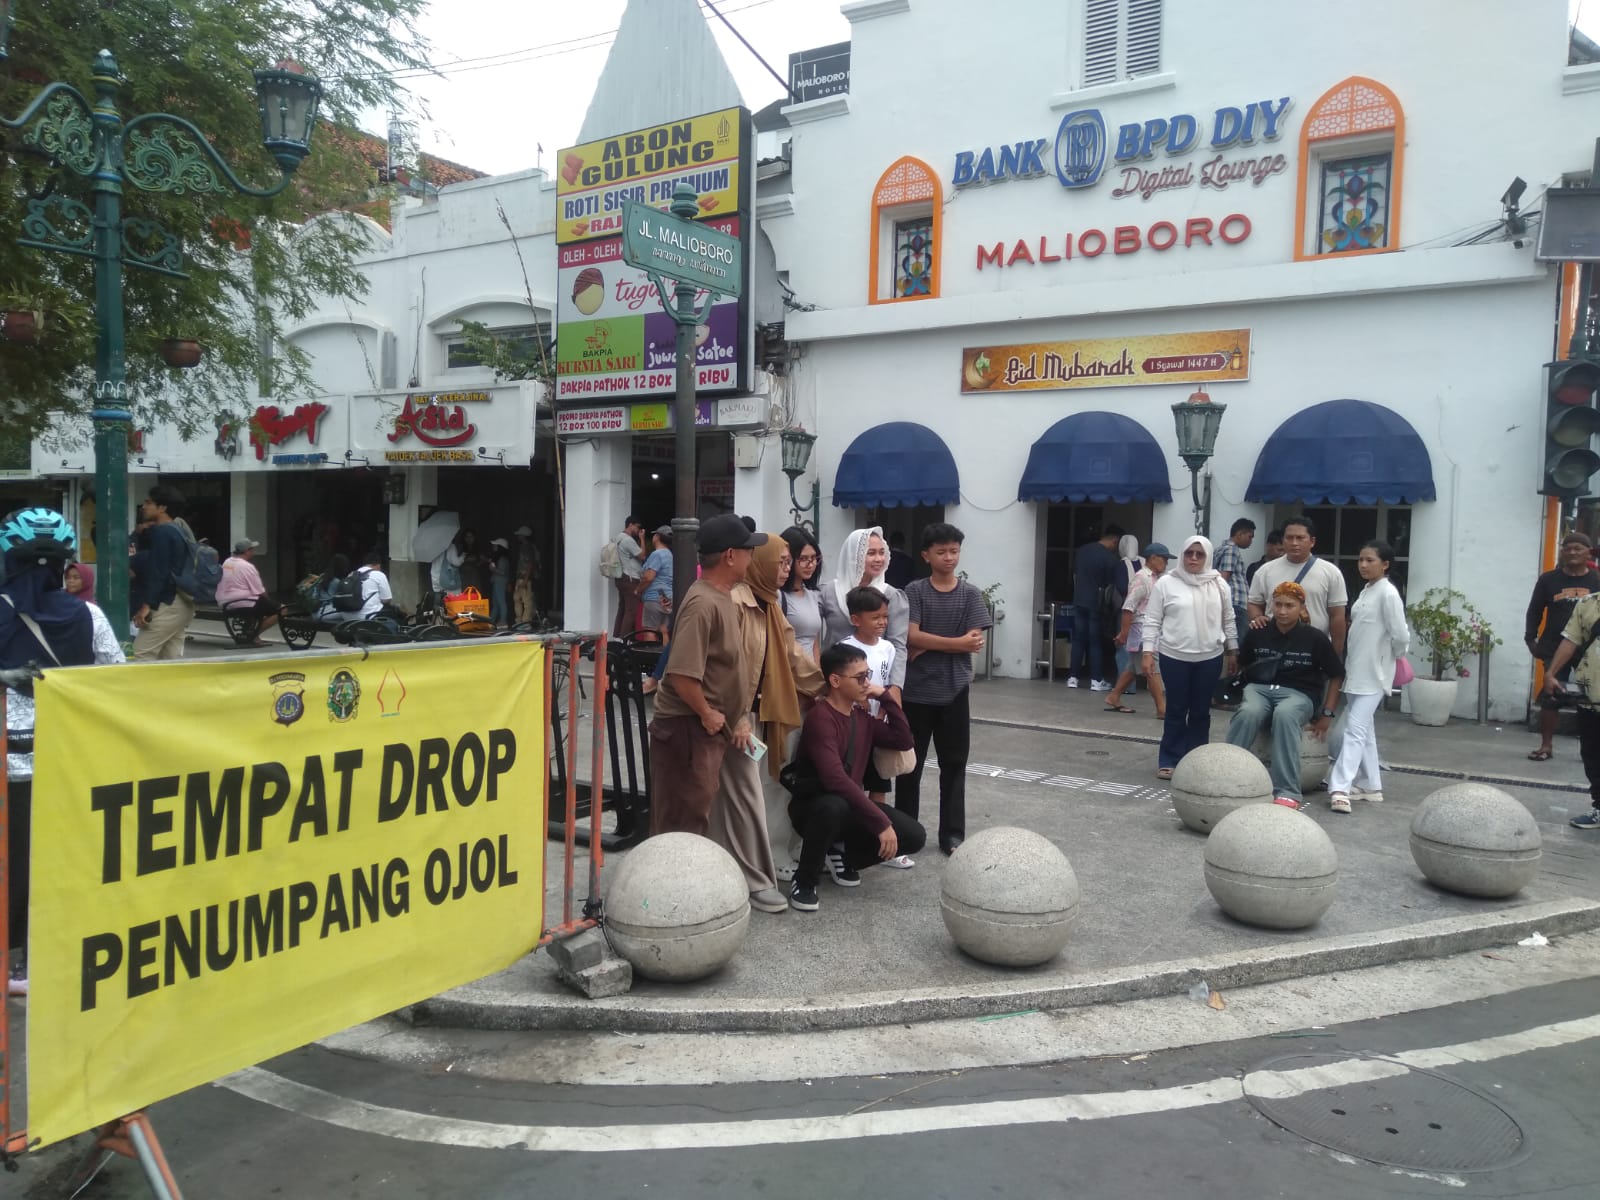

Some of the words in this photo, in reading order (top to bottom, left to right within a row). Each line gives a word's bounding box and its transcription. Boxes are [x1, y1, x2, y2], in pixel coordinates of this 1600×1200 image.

[797, 71, 846, 88] MALIOBORO
[602, 122, 692, 162] ABON
[952, 138, 1047, 185] BANK
[1114, 113, 1198, 161] BPD
[1210, 97, 1290, 146] DIY
[582, 140, 714, 187] GULUNG
[1111, 162, 1194, 199] Digital
[1200, 153, 1287, 187] Lounge
[565, 194, 599, 219] ROTI
[563, 249, 585, 264] OLEH
[594, 244, 616, 259] OLEH
[639, 220, 657, 239] JL.
[659, 226, 733, 265] MALIOBORO
[977, 213, 1252, 271] MALIOBORO
[557, 359, 603, 374] KURNIA
[606, 355, 636, 371] SARI
[583, 348, 613, 358] BAKPIA
[697, 337, 734, 361] satoe
[1156, 359, 1184, 372] Syawal
[1187, 357, 1208, 368] 1447
[560, 379, 592, 395] BAKPIA
[594, 376, 630, 392] PATHOK
[633, 374, 647, 389] 12
[648, 374, 672, 389] BOX
[699, 368, 729, 385] RIBU
[1005, 353, 1037, 385] Eid
[1041, 348, 1135, 382] Mubarak
[387, 394, 475, 447] Asia
[559, 422, 567, 431] 12
[569, 422, 584, 431] BOX
[587, 420, 600, 430] 100
[602, 419, 621, 430] RIBU
[600, 409, 623, 419] PATHOK
[91, 748, 363, 885] TEMPAT
[377, 728, 517, 823] DROP
[80, 857, 410, 1012] PENUMPANG
[424, 834, 518, 906] OJOL
